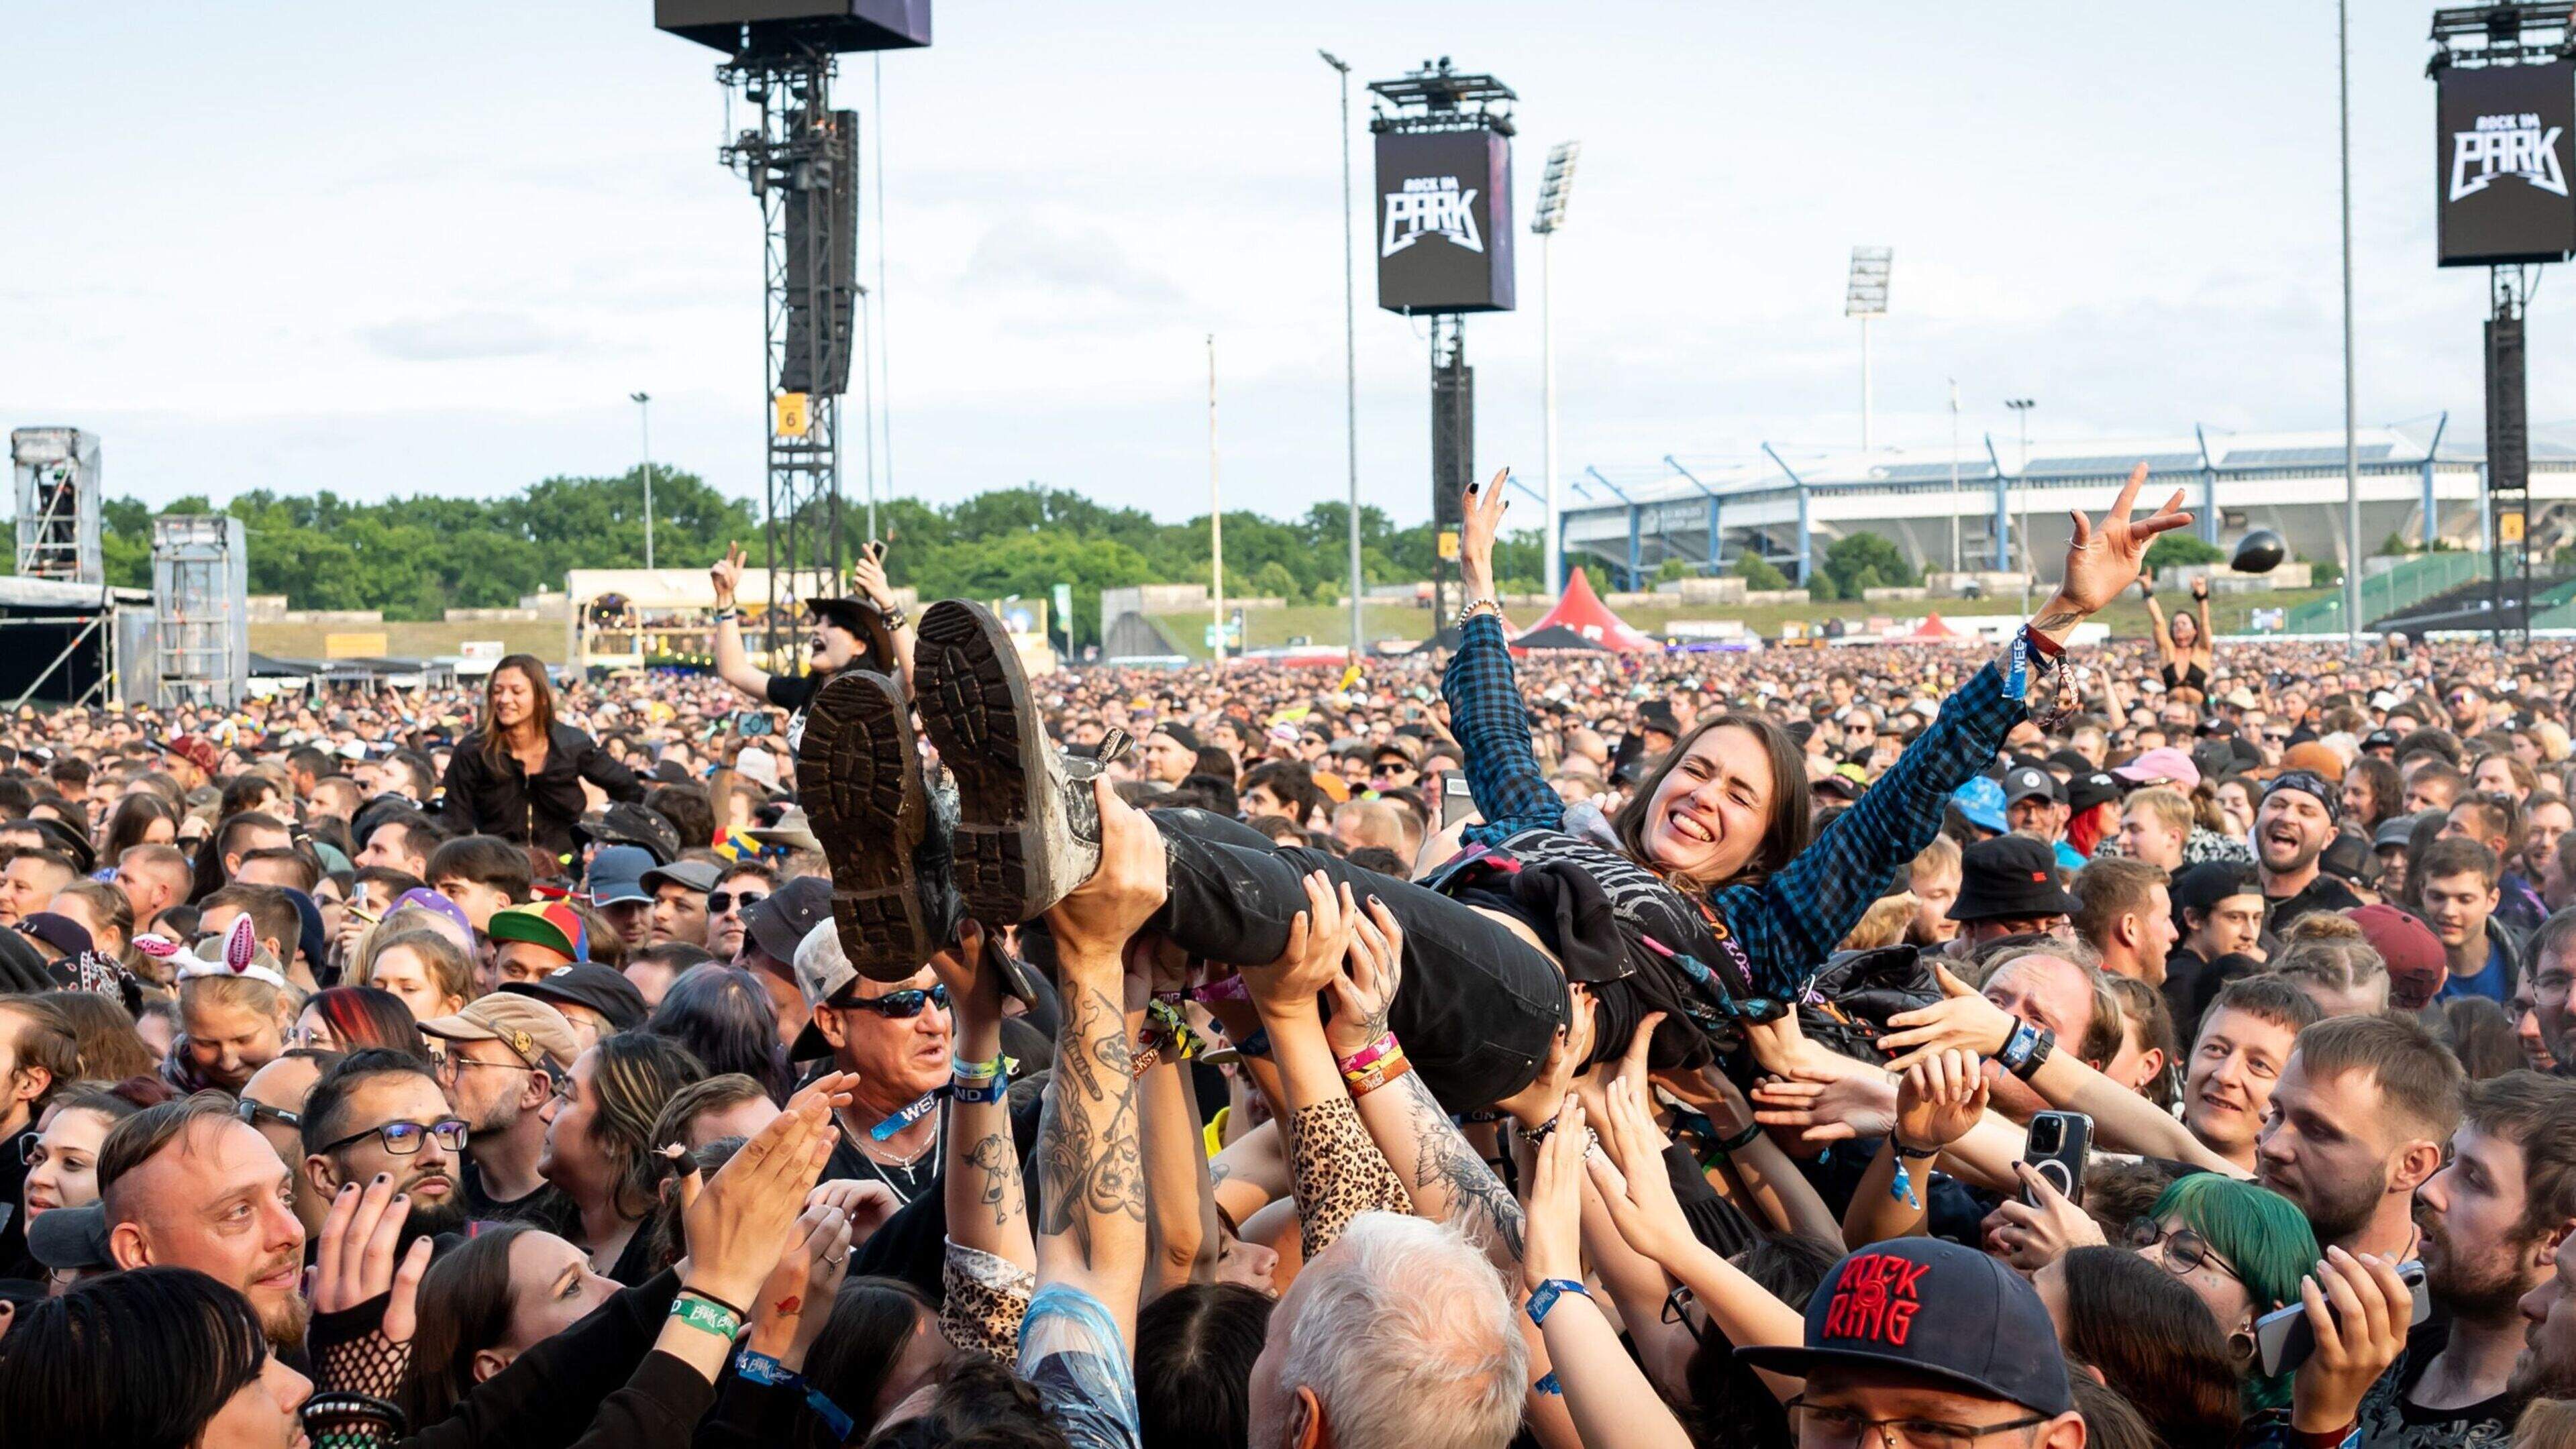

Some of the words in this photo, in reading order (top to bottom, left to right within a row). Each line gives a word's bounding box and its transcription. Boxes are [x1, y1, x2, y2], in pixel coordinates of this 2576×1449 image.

[2450, 126, 2569, 202] PARK
[1382, 189, 1484, 258] PARK
[786, 411, 796, 427] 6
[955, 1087, 982, 1101] ND
[1836, 1252, 1930, 1299] ROCK
[1822, 1293, 1921, 1347] RING
